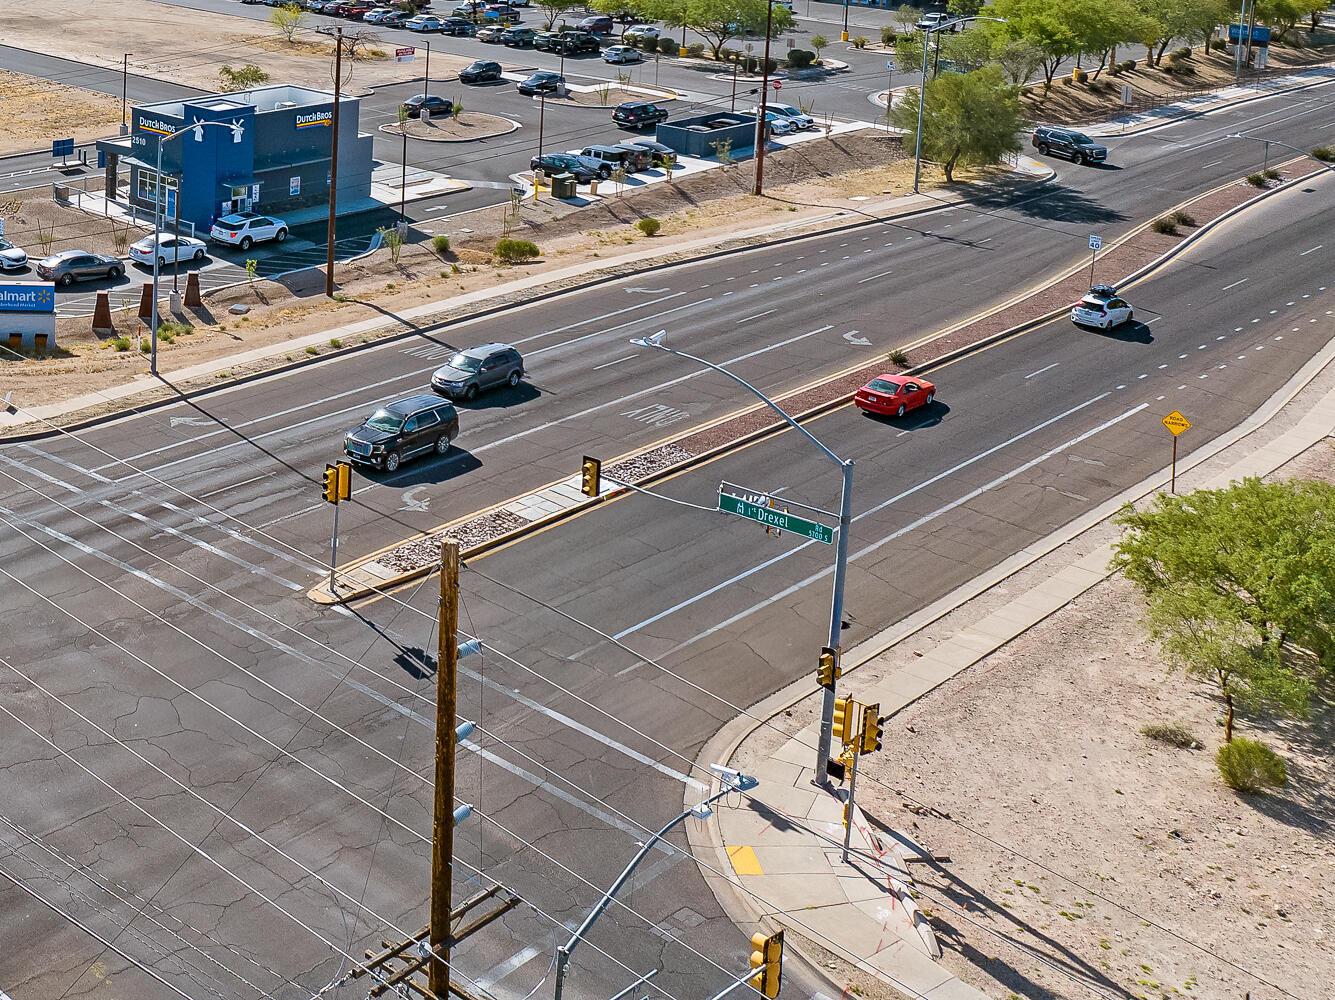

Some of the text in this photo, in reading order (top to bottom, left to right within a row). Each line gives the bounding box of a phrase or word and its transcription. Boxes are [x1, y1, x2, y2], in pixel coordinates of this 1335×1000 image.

[296, 111, 332, 124] DUTCH BROS
[139, 116, 176, 133] DUTCH BROS
[132, 136, 147, 146] 2510
[757, 508, 789, 528] Drexel
[808, 529, 823, 540] 5700
